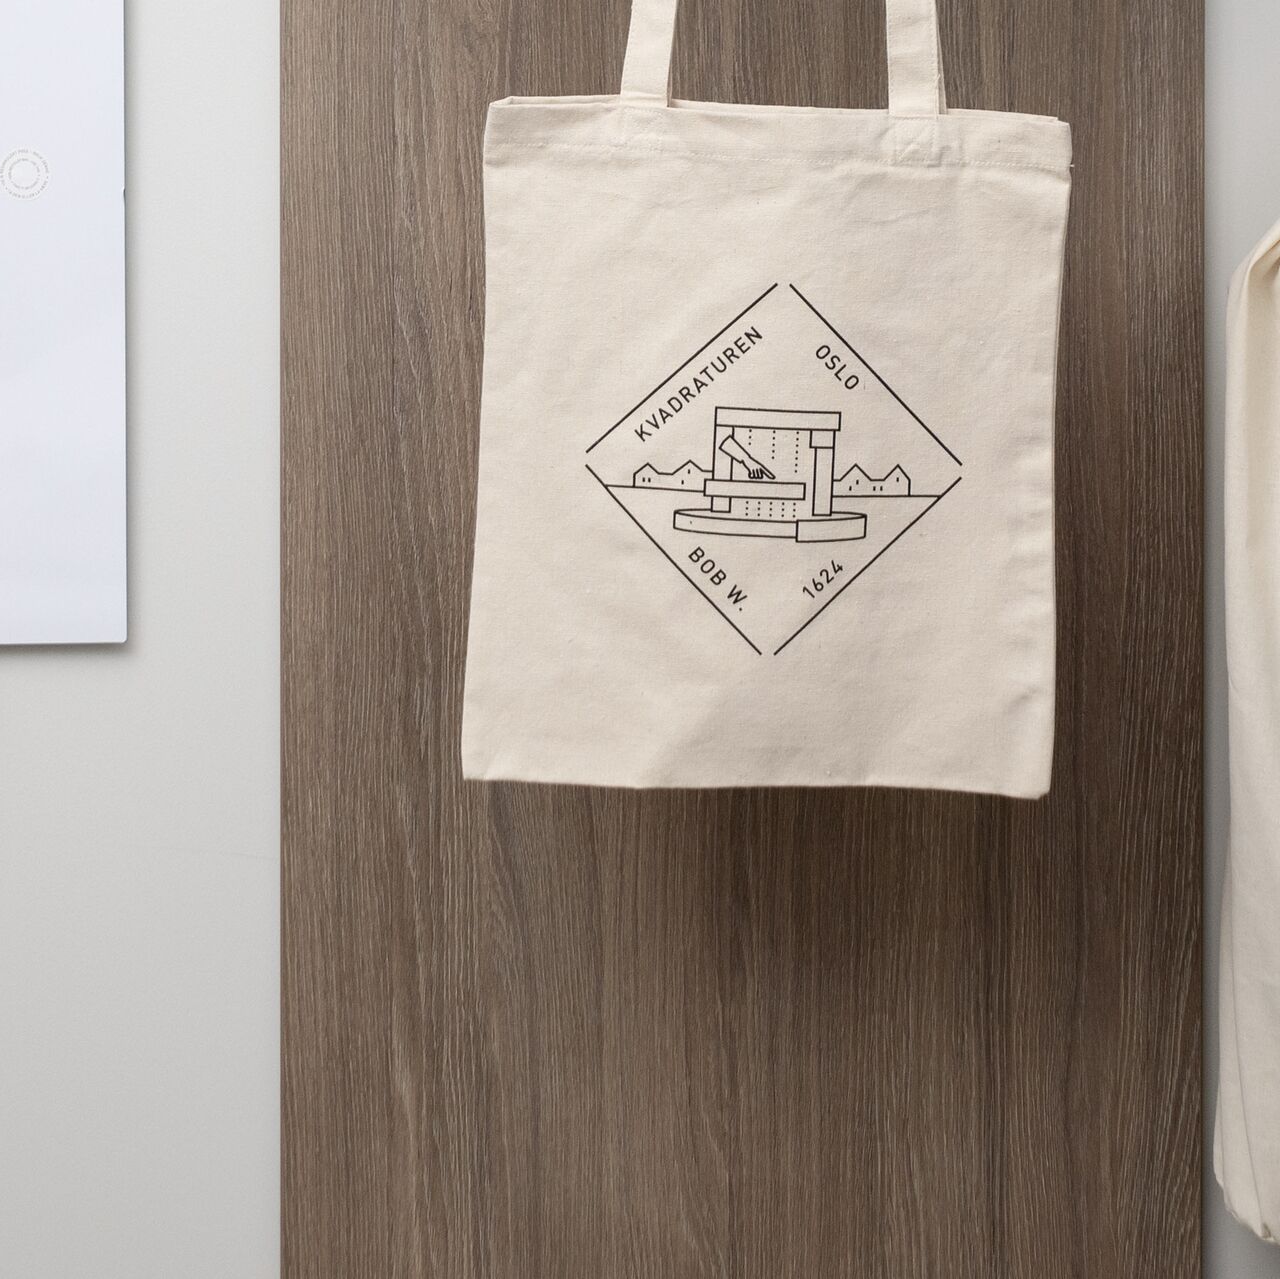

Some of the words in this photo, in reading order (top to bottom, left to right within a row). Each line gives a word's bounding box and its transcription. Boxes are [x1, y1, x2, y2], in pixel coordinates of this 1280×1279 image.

[632, 325, 764, 443] KVADRATUREN
[814, 344, 861, 392] OSLO
[687, 545, 727, 587] BOB
[726, 583, 748, 612] W.
[801, 558, 845, 600] 1624
